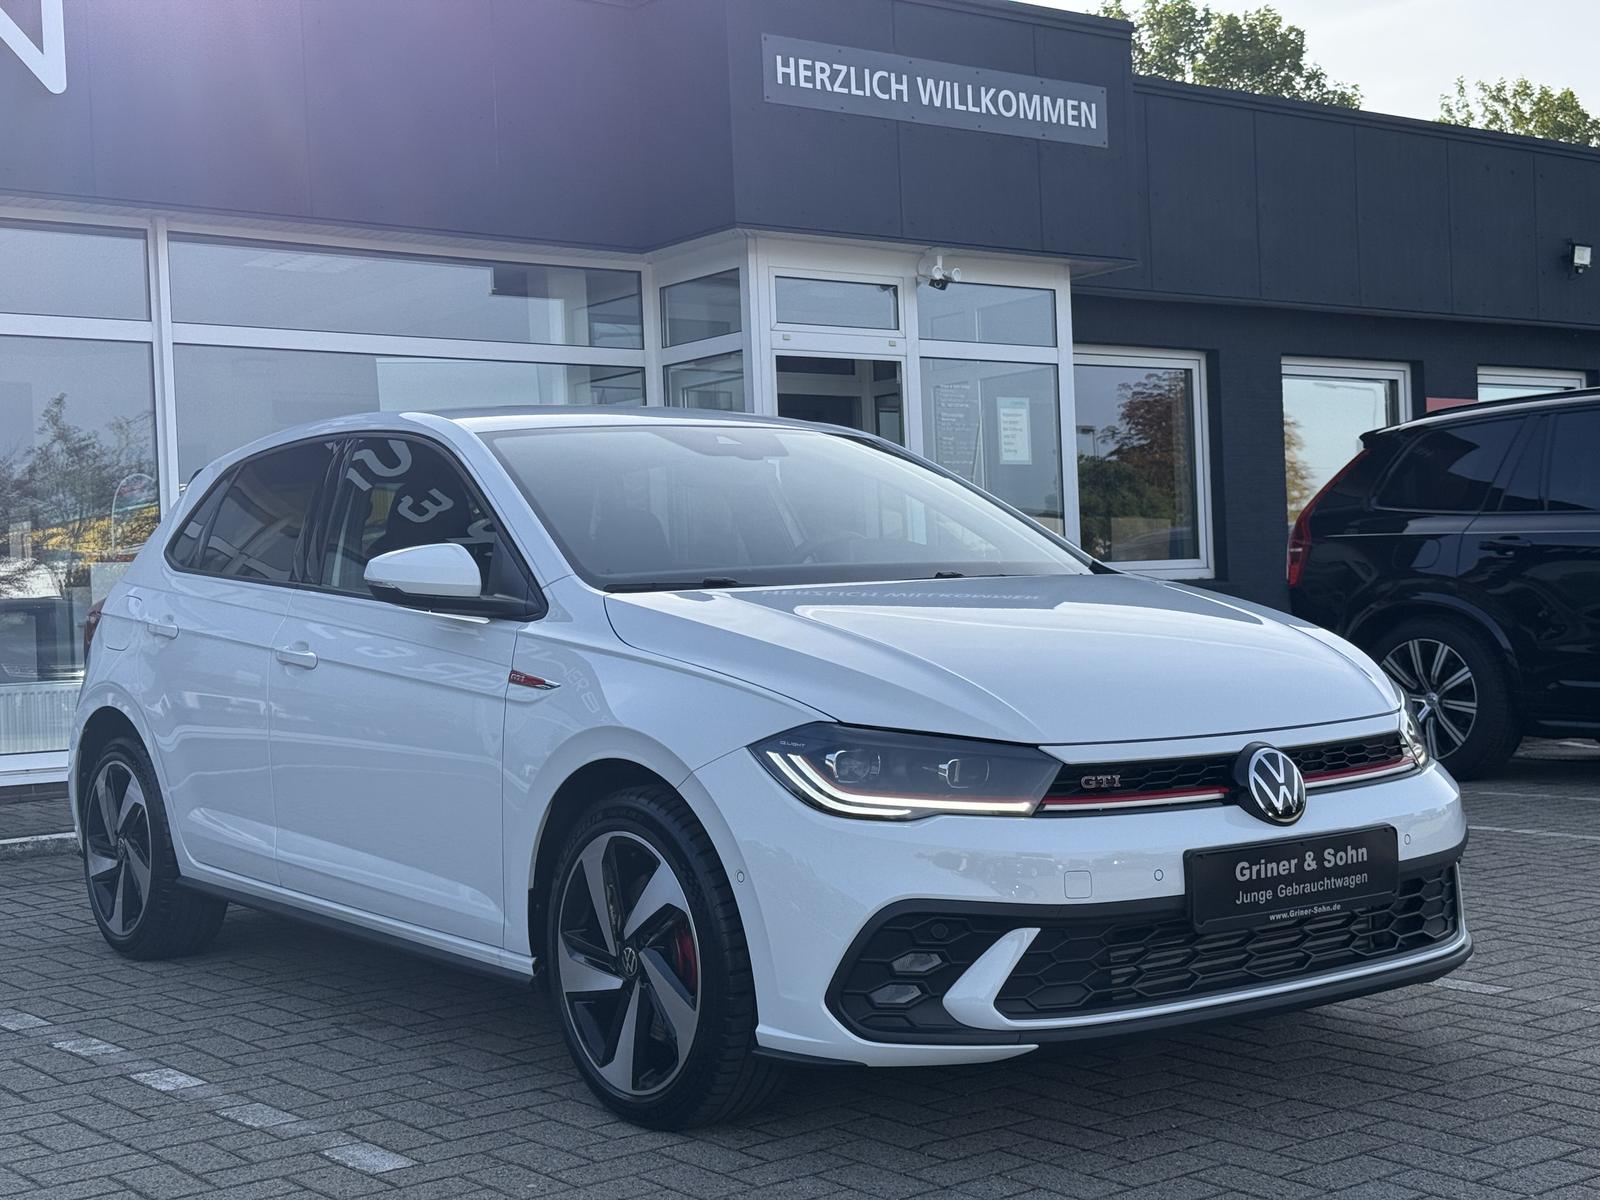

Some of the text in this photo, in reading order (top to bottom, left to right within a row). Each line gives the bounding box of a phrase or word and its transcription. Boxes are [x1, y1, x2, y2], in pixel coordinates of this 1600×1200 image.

[775, 55, 1098, 130] HERZLICH WILLKOMMEN
[1080, 774, 1121, 789] GTI
[1235, 845, 1368, 882] Griner & Sohn
[1235, 872, 1369, 905] Junge Gebrauchtwagen
[1269, 903, 1342, 921] www.Griner-Sohn.de
